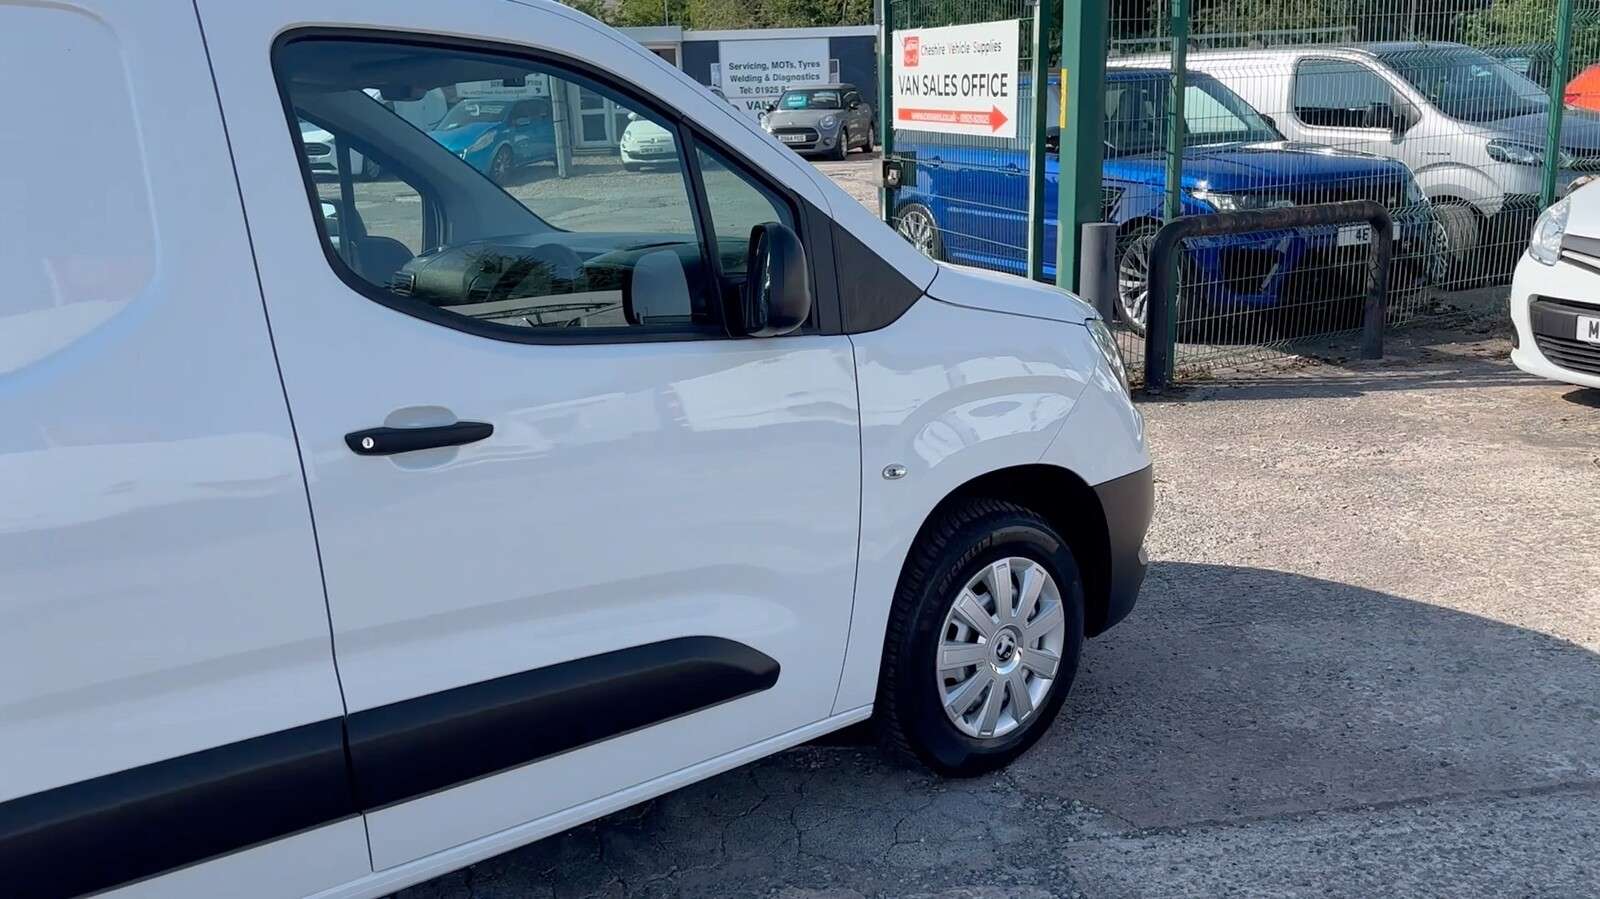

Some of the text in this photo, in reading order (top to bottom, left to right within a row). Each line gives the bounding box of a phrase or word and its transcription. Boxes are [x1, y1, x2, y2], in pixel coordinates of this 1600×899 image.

[921, 44, 946, 57] Cheshire
[948, 41, 970, 54] Vehicle
[973, 39, 1002, 56] Supplies
[728, 60, 821, 72] Servicing, MOTs, Tyres
[729, 72, 821, 84] Welding & Diagnostics
[898, 72, 1008, 97] VAN SALES OFFICE
[739, 86, 753, 95] Tel:
[754, 86, 779, 94] 01925
[938, 534, 992, 594] MICHELIN
